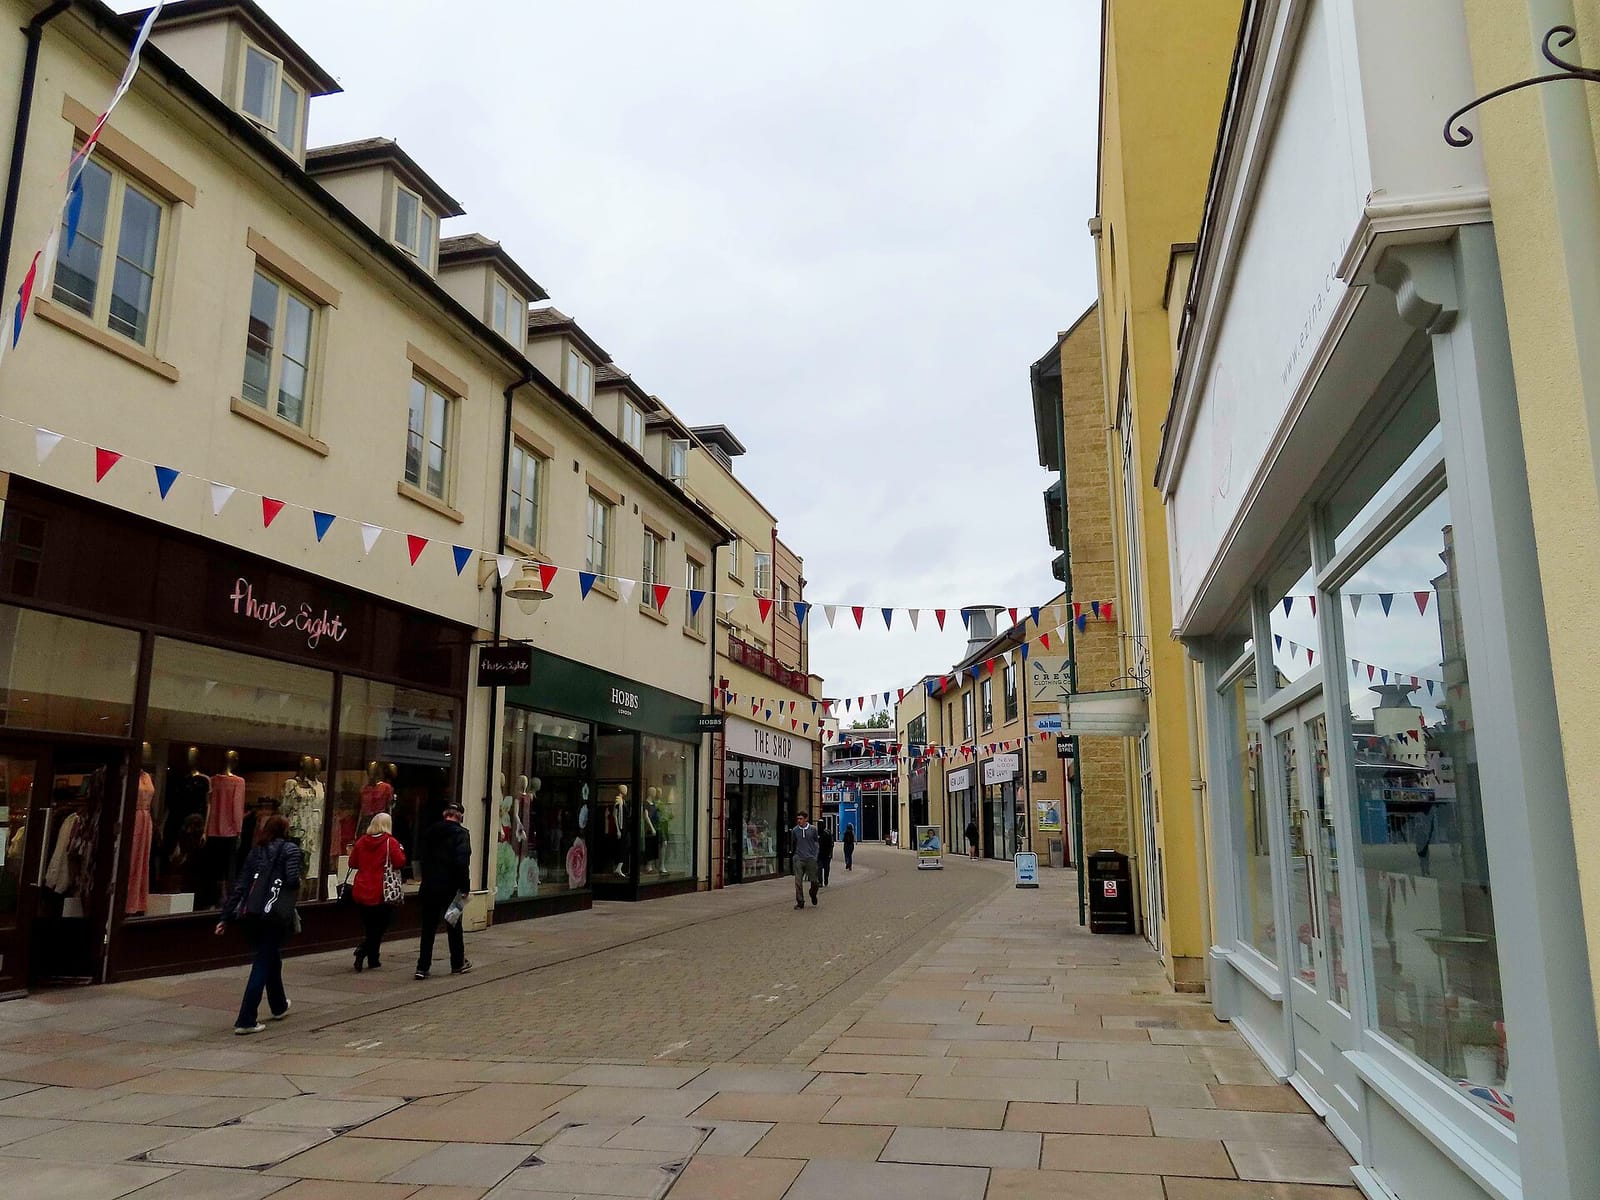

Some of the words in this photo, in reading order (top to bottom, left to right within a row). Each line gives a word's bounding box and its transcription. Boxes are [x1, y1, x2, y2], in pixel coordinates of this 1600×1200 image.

[229, 577, 294, 628] Phase
[295, 602, 347, 649] Eight
[1033, 672, 1072, 680] CREW
[611, 687, 639, 709] HOBBS
[617, 708, 632, 716] LONDON
[699, 718, 722, 726] HOBBS
[754, 728, 769, 754] THE
[773, 734, 792, 759] SHOP
